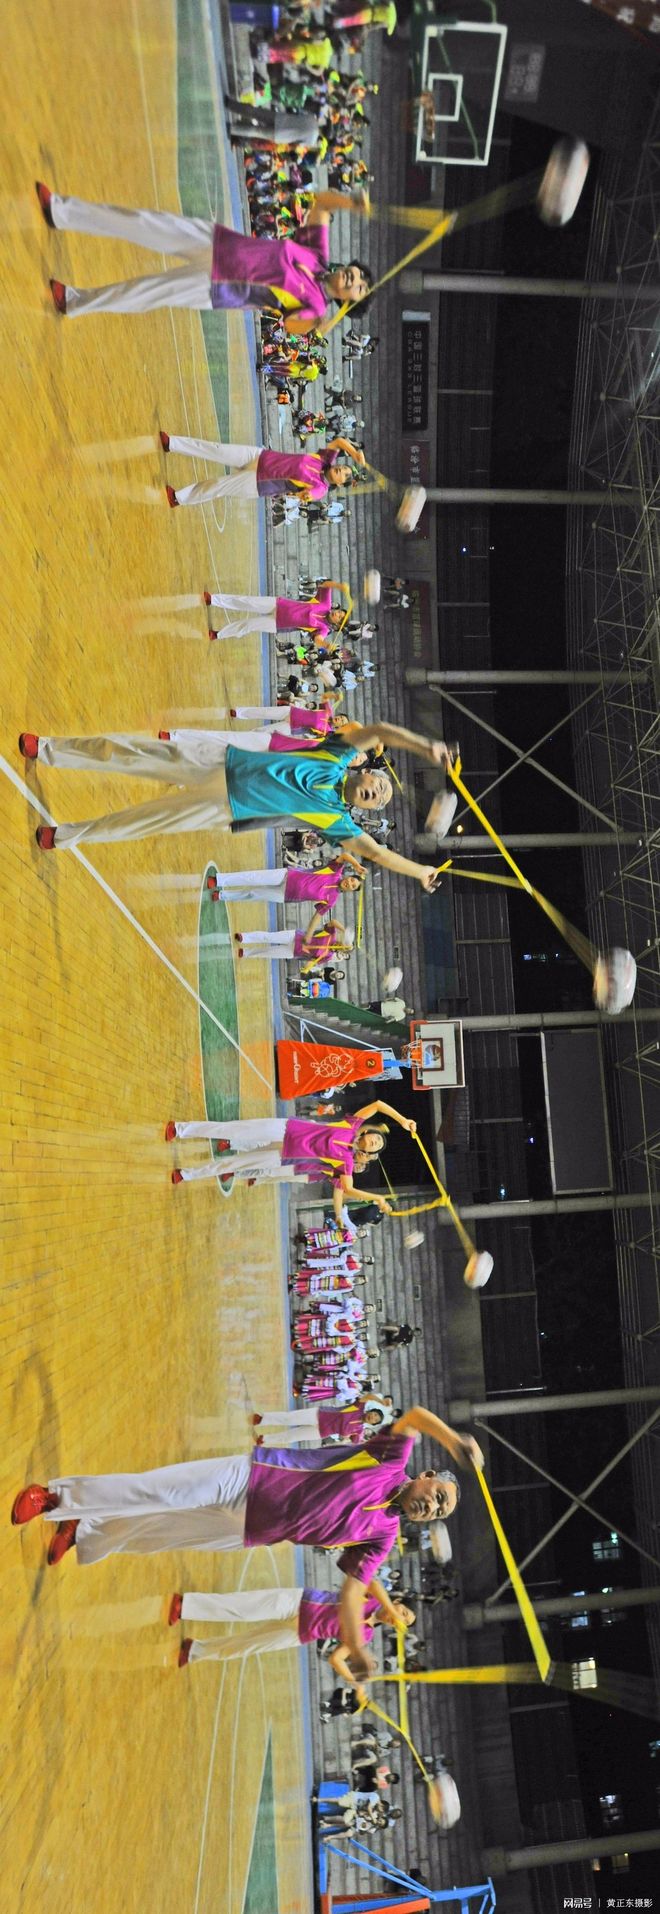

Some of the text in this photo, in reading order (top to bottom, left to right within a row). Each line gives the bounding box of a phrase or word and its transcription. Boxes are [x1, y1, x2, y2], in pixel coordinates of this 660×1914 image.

[413, 330, 422, 424] 中国三对三篮球联赛
